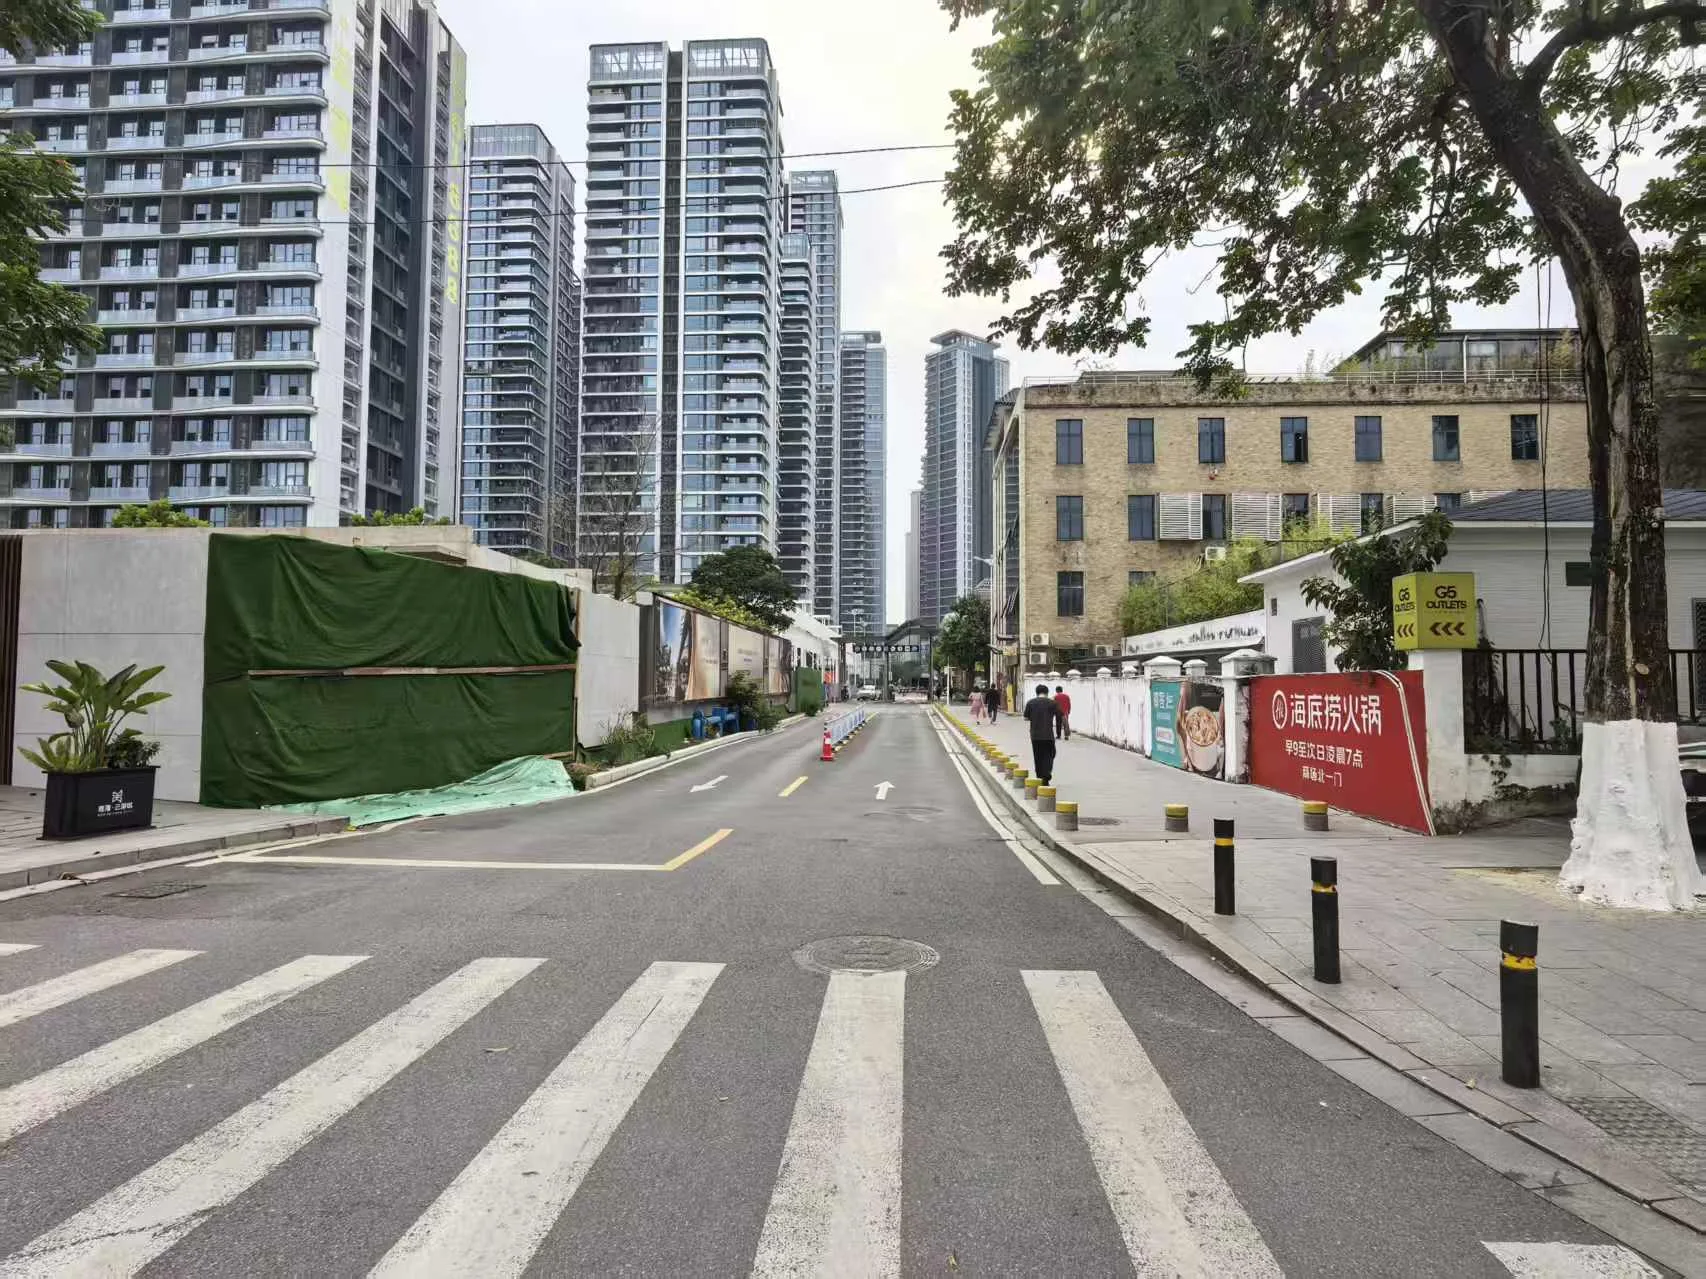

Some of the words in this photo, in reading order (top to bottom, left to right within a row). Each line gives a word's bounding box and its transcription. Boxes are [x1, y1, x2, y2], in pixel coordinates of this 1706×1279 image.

[1435, 585, 1457, 599] G5
[1425, 599, 1468, 609] OUTLETS
[1290, 693, 1382, 736] 海底捞火锅
[1285, 739, 1363, 768] 早9至次日凌晨7点
